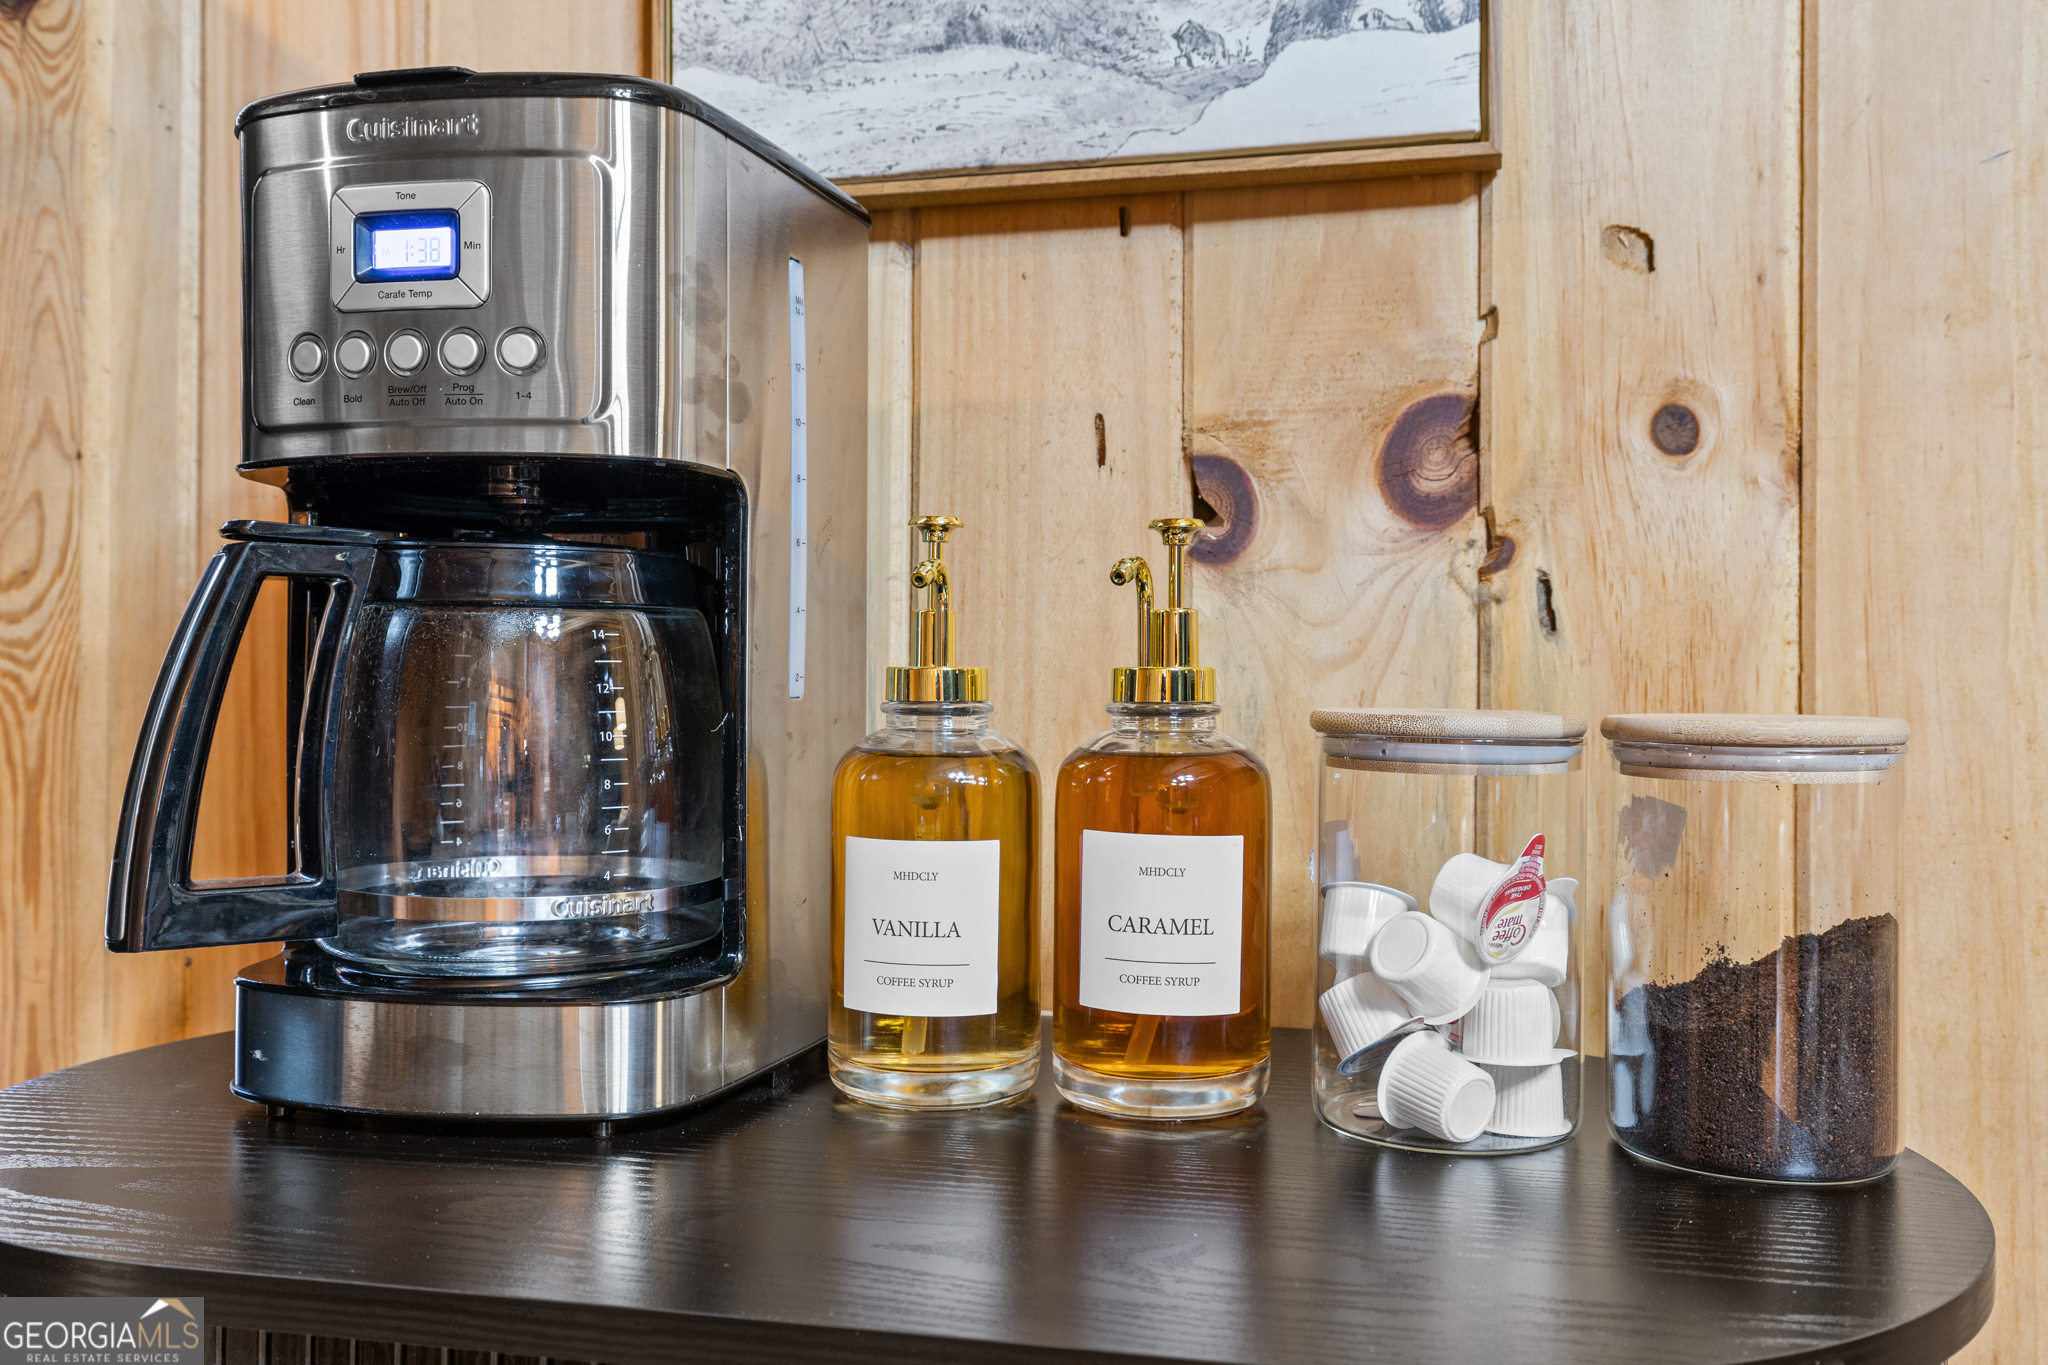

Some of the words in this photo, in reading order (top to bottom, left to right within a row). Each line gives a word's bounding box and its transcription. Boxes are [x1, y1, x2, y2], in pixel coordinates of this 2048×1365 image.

[345, 112, 480, 142] Cuisinart
[395, 191, 417, 200] Tone
[336, 246, 346, 254] Hr
[405, 237, 441, 263] 1:38
[463, 241, 482, 250] Min
[377, 290, 406, 299] Carafe
[408, 289, 433, 299] Temp
[795, 363, 801, 371] 12
[387, 384, 427, 394] Brew/Off
[452, 383, 475, 393] Prog
[343, 394, 363, 403] Bold
[444, 396, 467, 405] Auto
[469, 396, 483, 405] On
[515, 391, 532, 400] 1-4
[293, 397, 316, 407] Clean
[388, 397, 410, 407] Auto
[411, 397, 426, 406] Off
[795, 418, 801, 426] 10
[796, 475, 801, 483] 8
[796, 538, 801, 546] 6
[796, 606, 800, 614] 4
[591, 629, 605, 640] 14
[795, 673, 800, 682] 2
[596, 683, 610, 694] 12
[599, 730, 613, 742] 10
[603, 778, 611, 790] 8
[604, 824, 612, 835] 6
[603, 869, 611, 881] 4
[893, 870, 939, 882] MHDCLY
[1138, 866, 1186, 878] MHDCLY
[1504, 884, 1532, 896] ORIGINAL
[1509, 891, 1522, 899] THE
[550, 892, 655, 918] Cuisinart
[1107, 914, 1215, 937] CARAMEL
[1497, 914, 1524, 929] mate
[871, 917, 962, 939] VANILLA
[1492, 925, 1527, 946] Coffee
[876, 975, 916, 988] COFFEE
[918, 976, 954, 989] SYRUP
[1118, 973, 1162, 986] COFFEE
[1164, 974, 1201, 988] SYRUP
